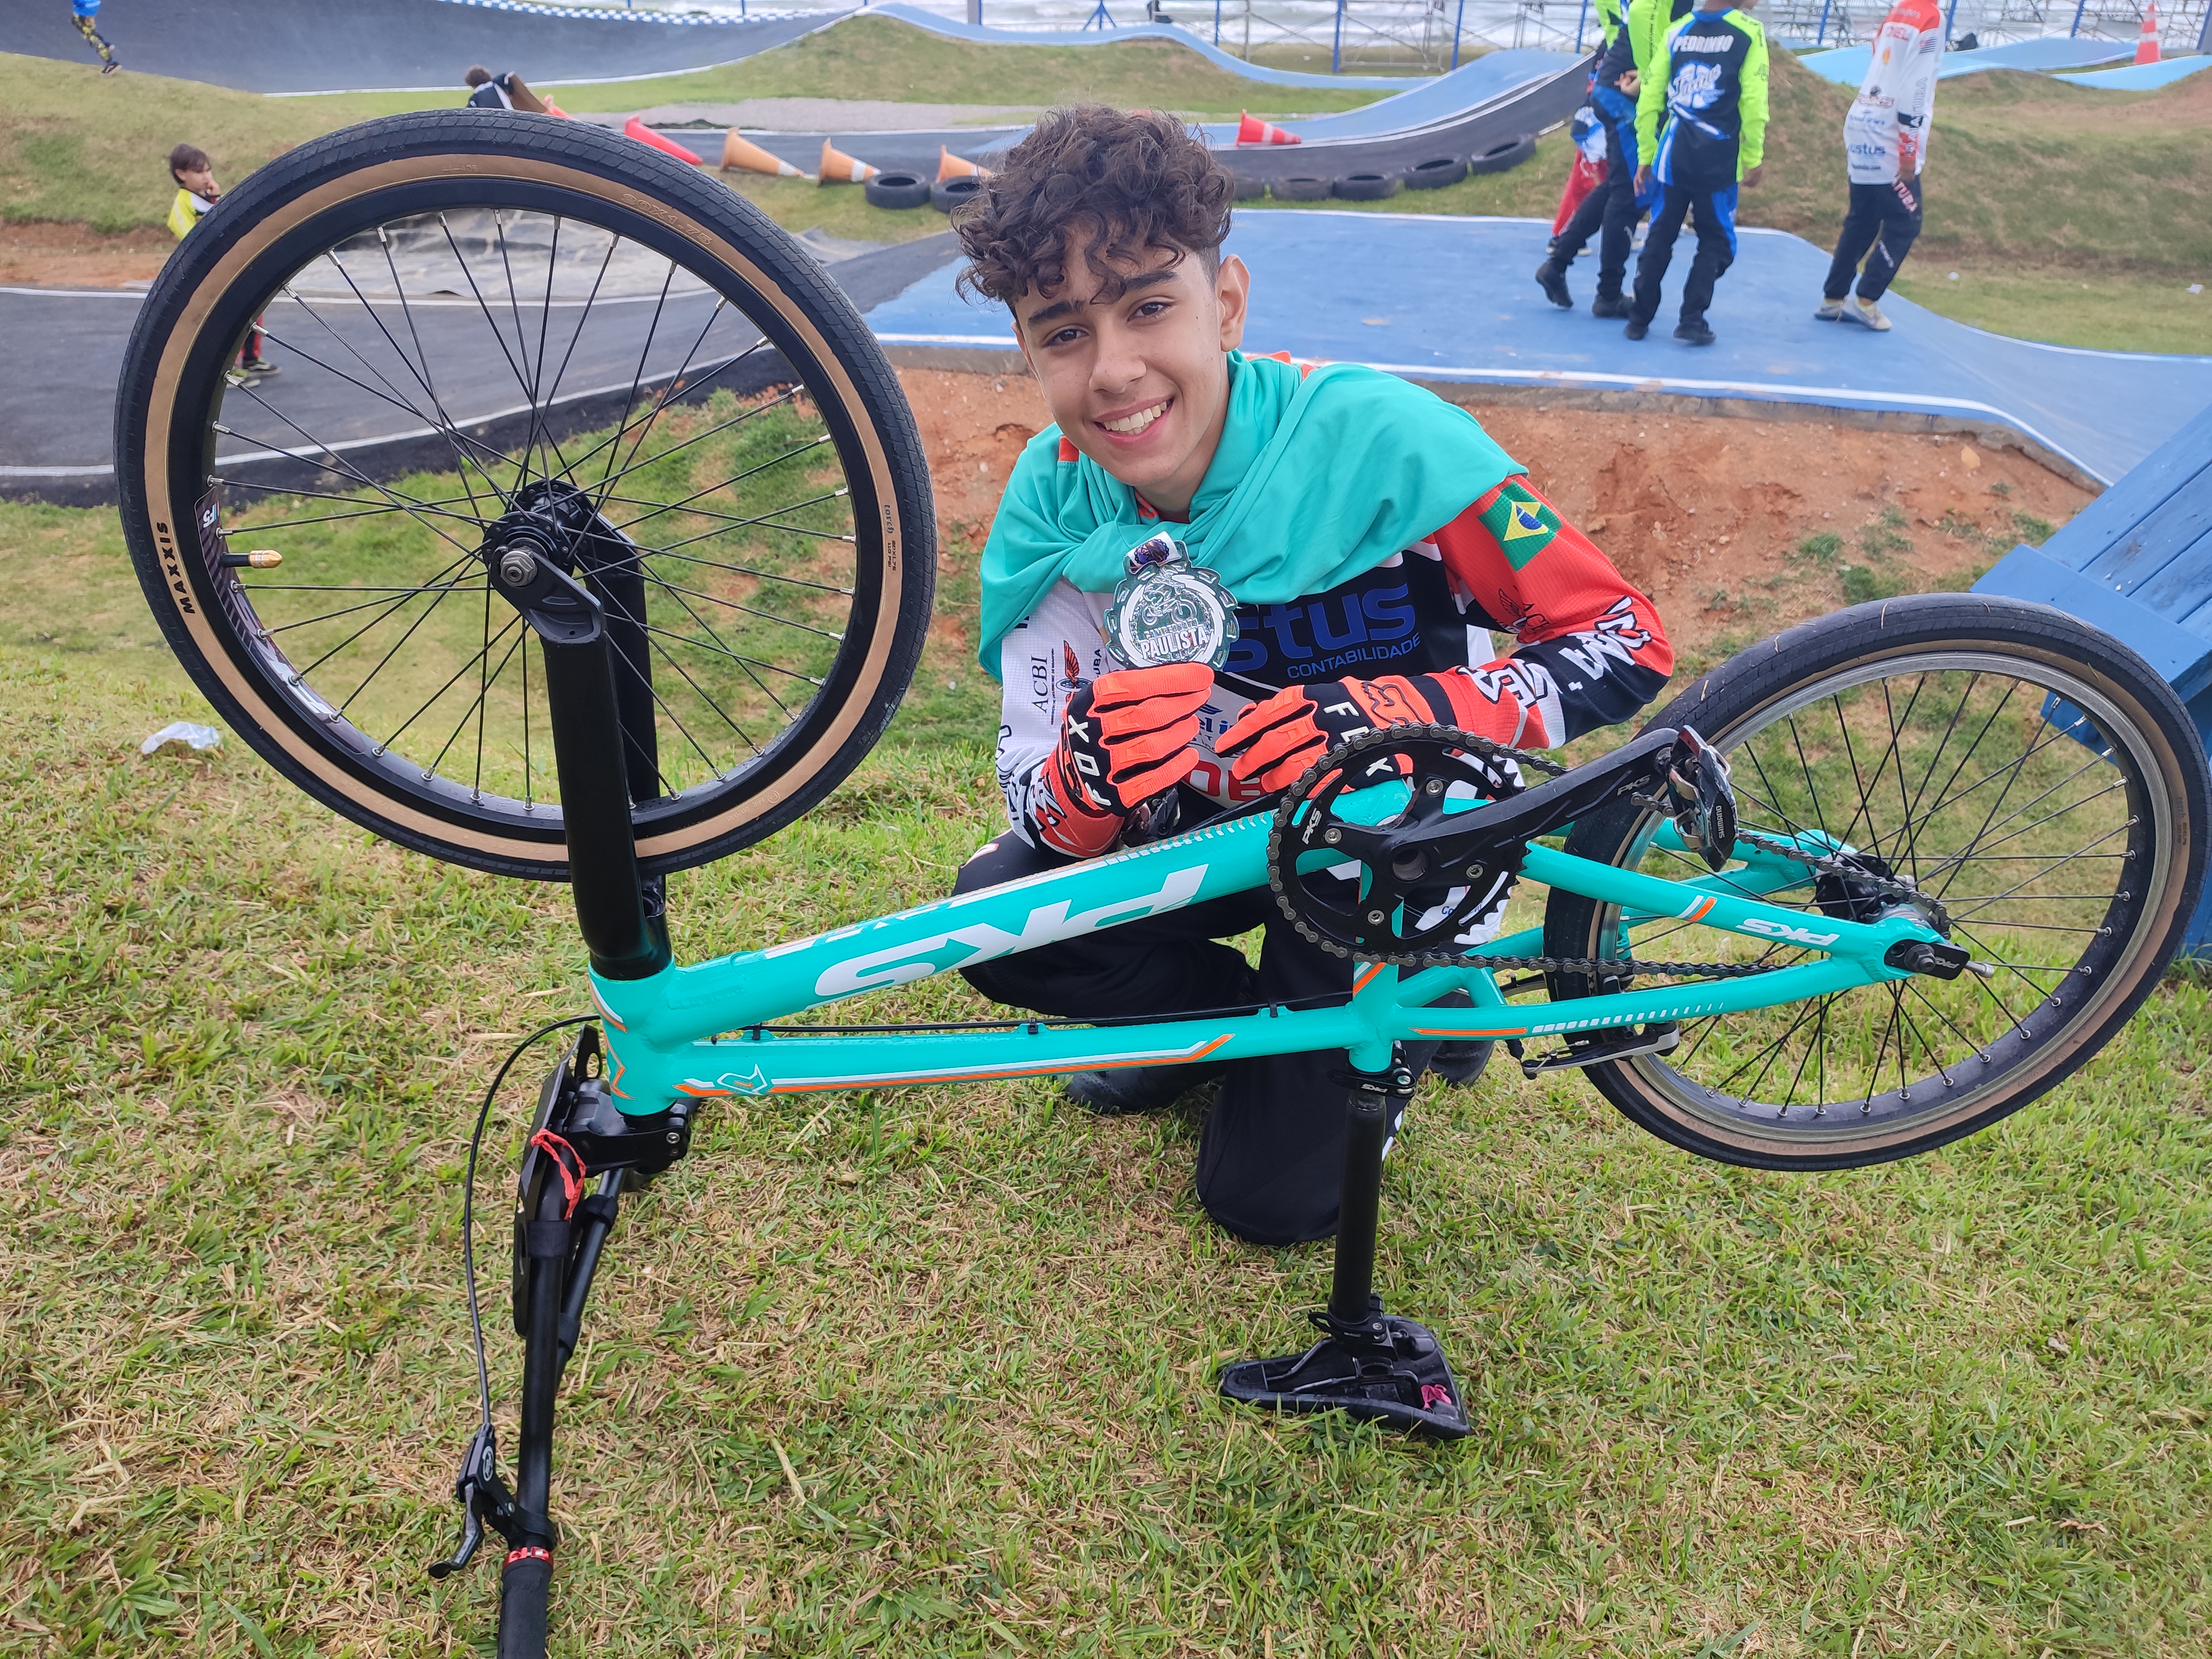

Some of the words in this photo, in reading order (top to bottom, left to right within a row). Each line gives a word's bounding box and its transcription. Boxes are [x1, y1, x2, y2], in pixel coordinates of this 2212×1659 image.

[156, 522, 195, 614] MAXXIS
[1141, 626, 1208, 658] PAULISTA
[1287, 635, 1421, 679] CONTABILIDADE
[1031, 655, 1048, 714] ACBI
[1302, 807, 1322, 844] PKS
[1715, 805, 1725, 839] SHIMANO
[1735, 917, 1840, 946] PKS
[1360, 1083, 1388, 1093] PKS
